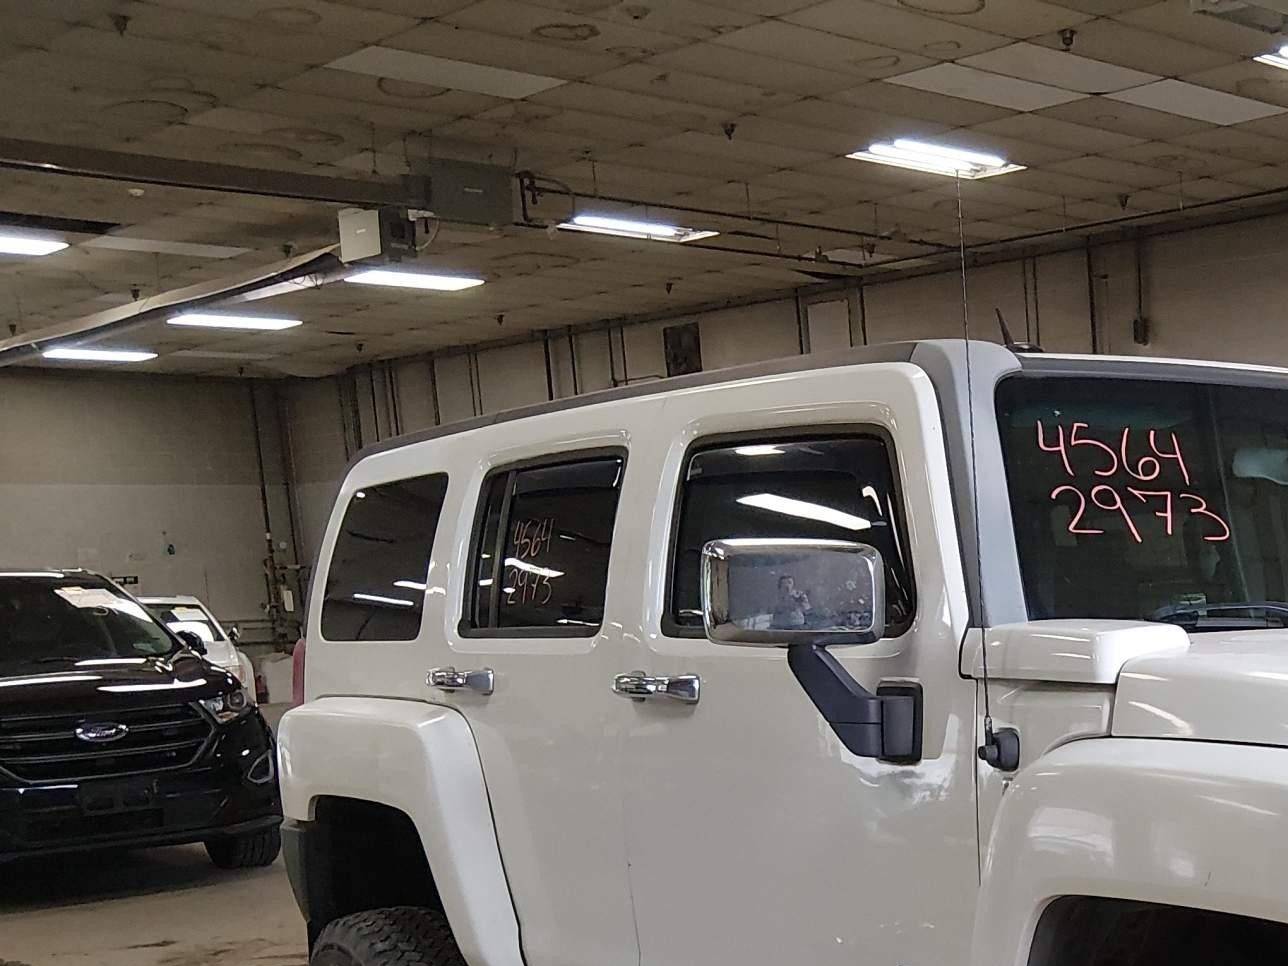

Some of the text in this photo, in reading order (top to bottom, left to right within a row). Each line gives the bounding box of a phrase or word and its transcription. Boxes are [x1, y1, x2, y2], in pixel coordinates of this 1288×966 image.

[1036, 419, 1190, 487] 4564
[513, 518, 555, 559] 4564
[1050, 484, 1231, 544] 2973
[506, 568, 553, 605] 2973
